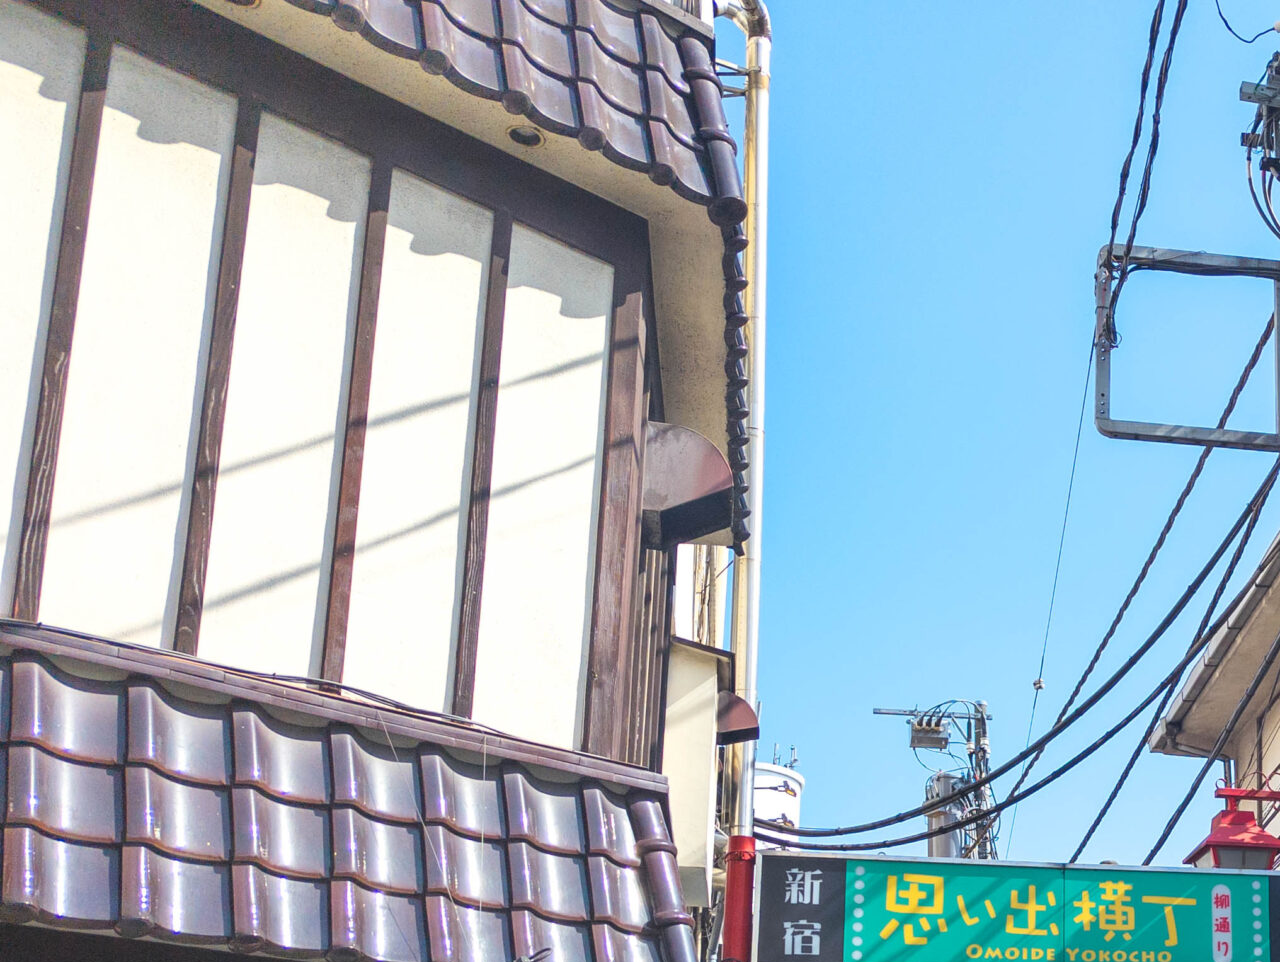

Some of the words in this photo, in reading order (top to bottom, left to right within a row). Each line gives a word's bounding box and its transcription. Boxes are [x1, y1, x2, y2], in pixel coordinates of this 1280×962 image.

[784, 868, 823, 955] 新宿
[879, 872, 1197, 947] 思い出横丁
[1213, 892, 1231, 957] 柳通り
[966, 943, 1056, 961] OMOIDE
[1066, 948, 1172, 962] YOKOCHO
